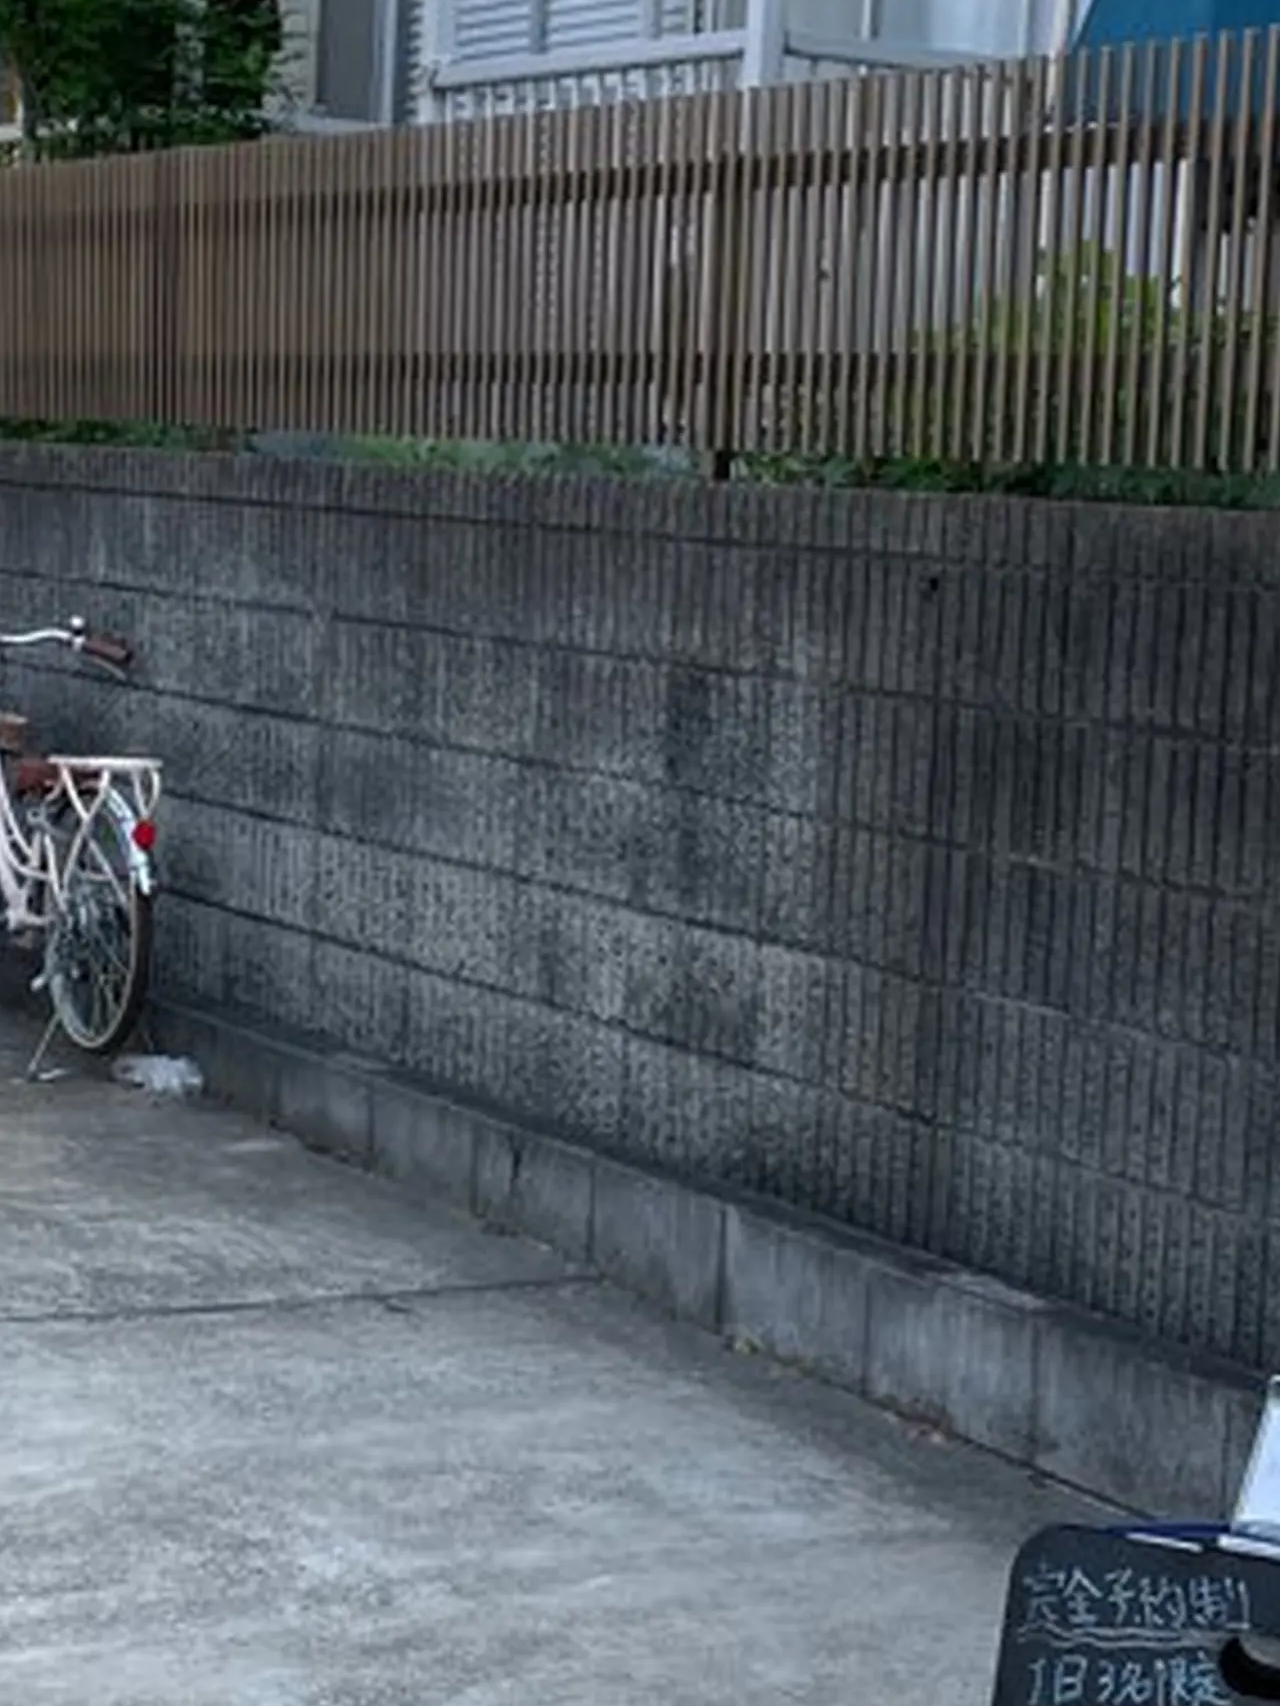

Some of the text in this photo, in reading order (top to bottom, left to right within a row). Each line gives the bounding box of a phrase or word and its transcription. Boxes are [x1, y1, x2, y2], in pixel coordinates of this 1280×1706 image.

[1022, 1562, 1251, 1630] 完全予約制
